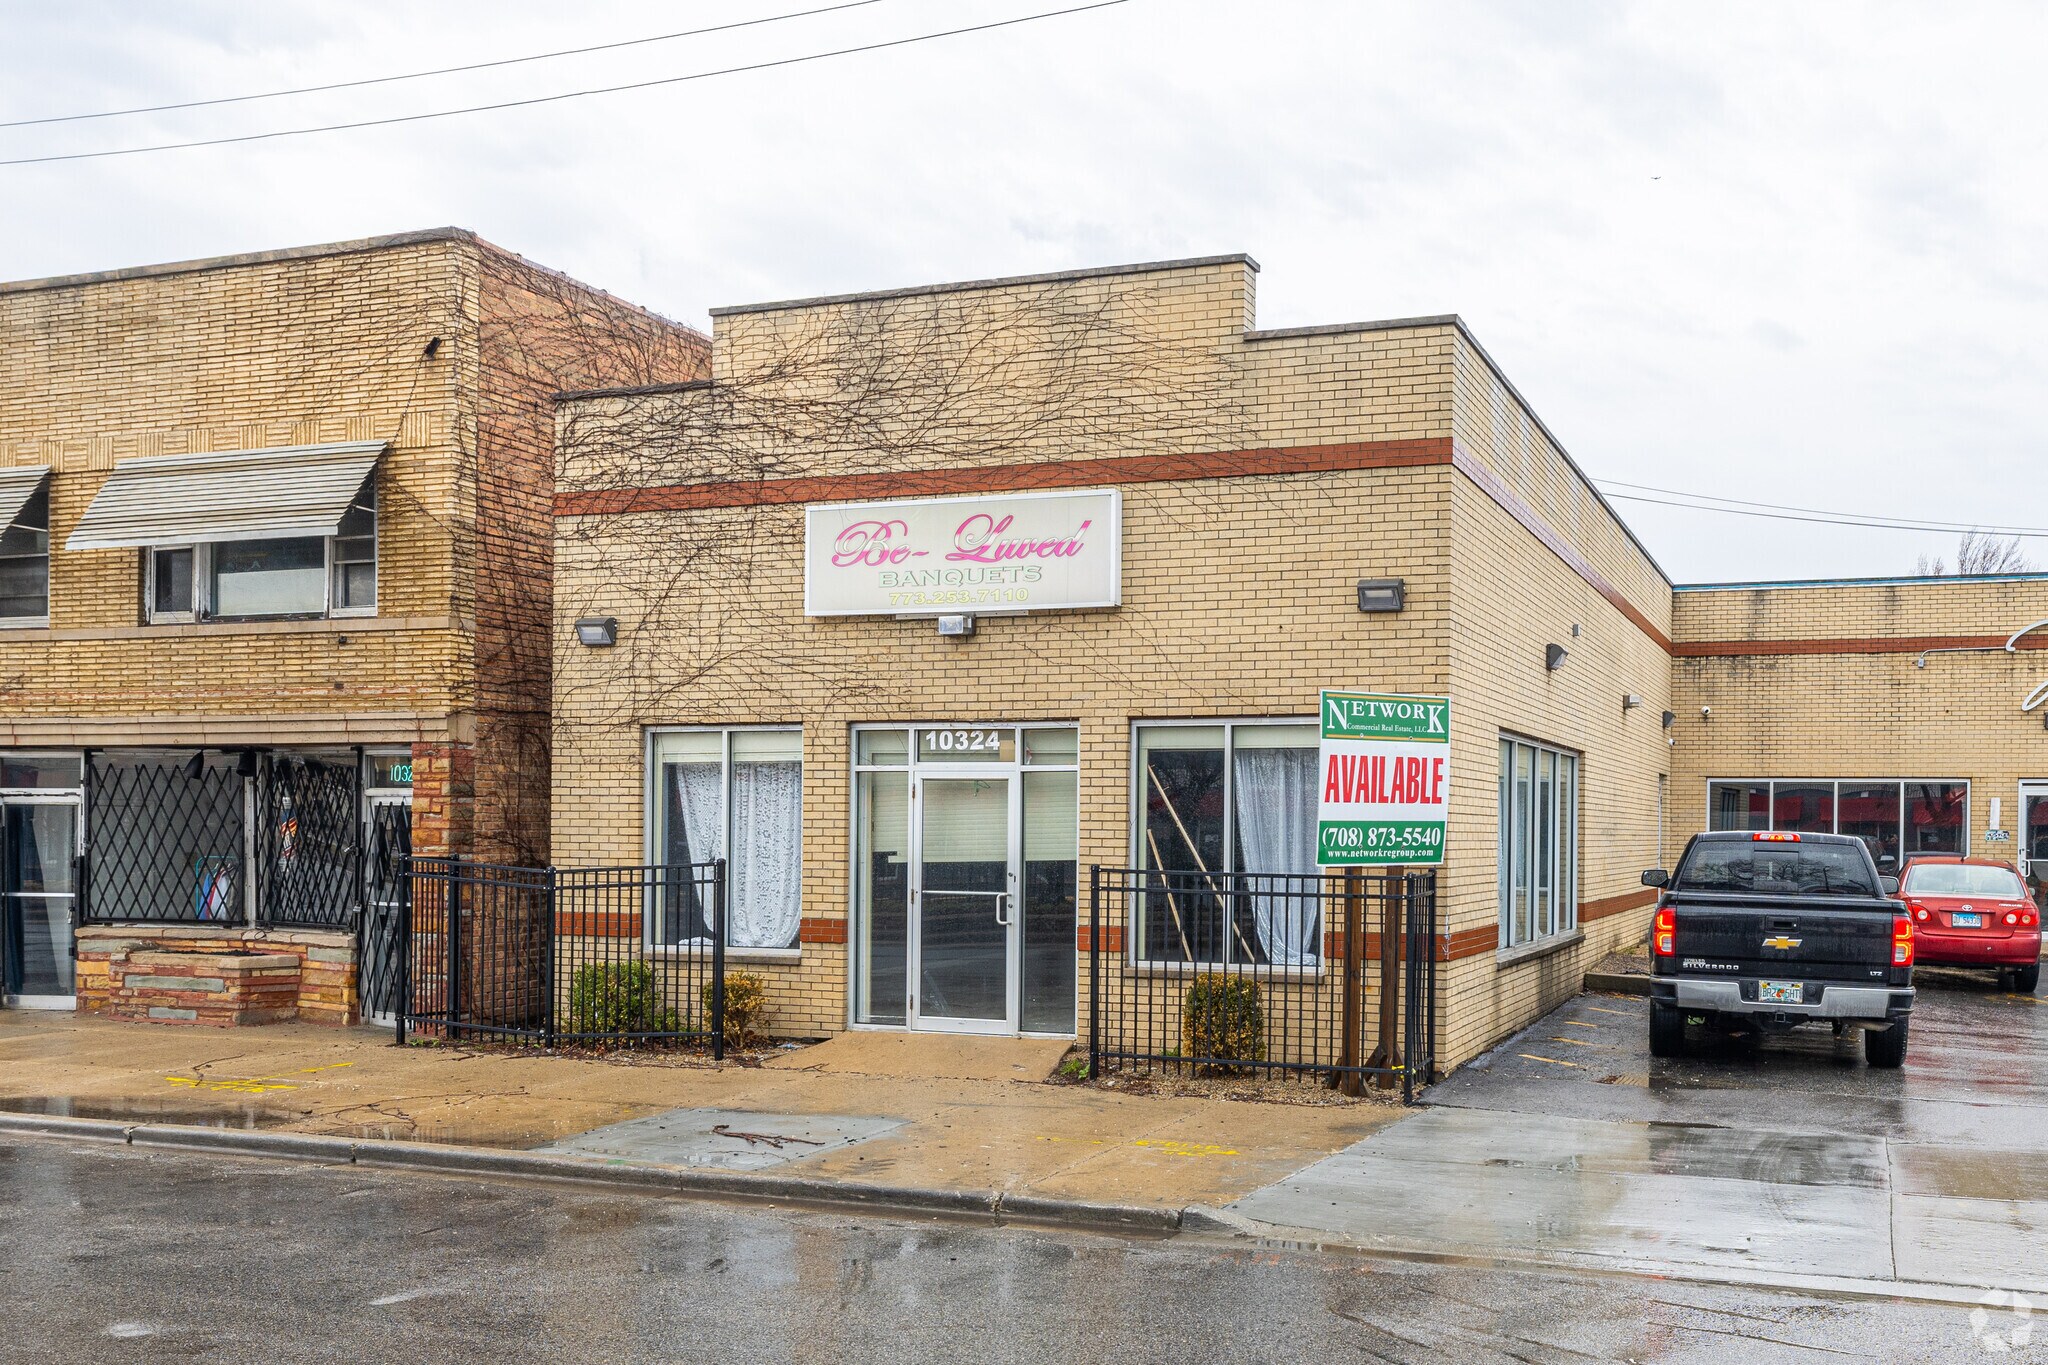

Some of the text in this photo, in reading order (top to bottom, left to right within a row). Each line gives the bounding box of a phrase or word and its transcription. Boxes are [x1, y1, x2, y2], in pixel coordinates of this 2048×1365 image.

[831, 513, 1092, 567] Be- Luved
[878, 565, 1042, 588] BANQUETS
[889, 588, 1029, 606] 773.253.7110
[1326, 699, 1445, 734] NETWORK
[1347, 723, 1427, 733] Commercial Real Estate, LLC
[925, 730, 1000, 751] 10324
[1324, 754, 1444, 804] AVAILABLE
[1322, 827, 1441, 848] (708) 873-5540
[1327, 848, 1434, 858] www.networkregroup.com
[1682, 961, 1740, 970] SILVERADO
